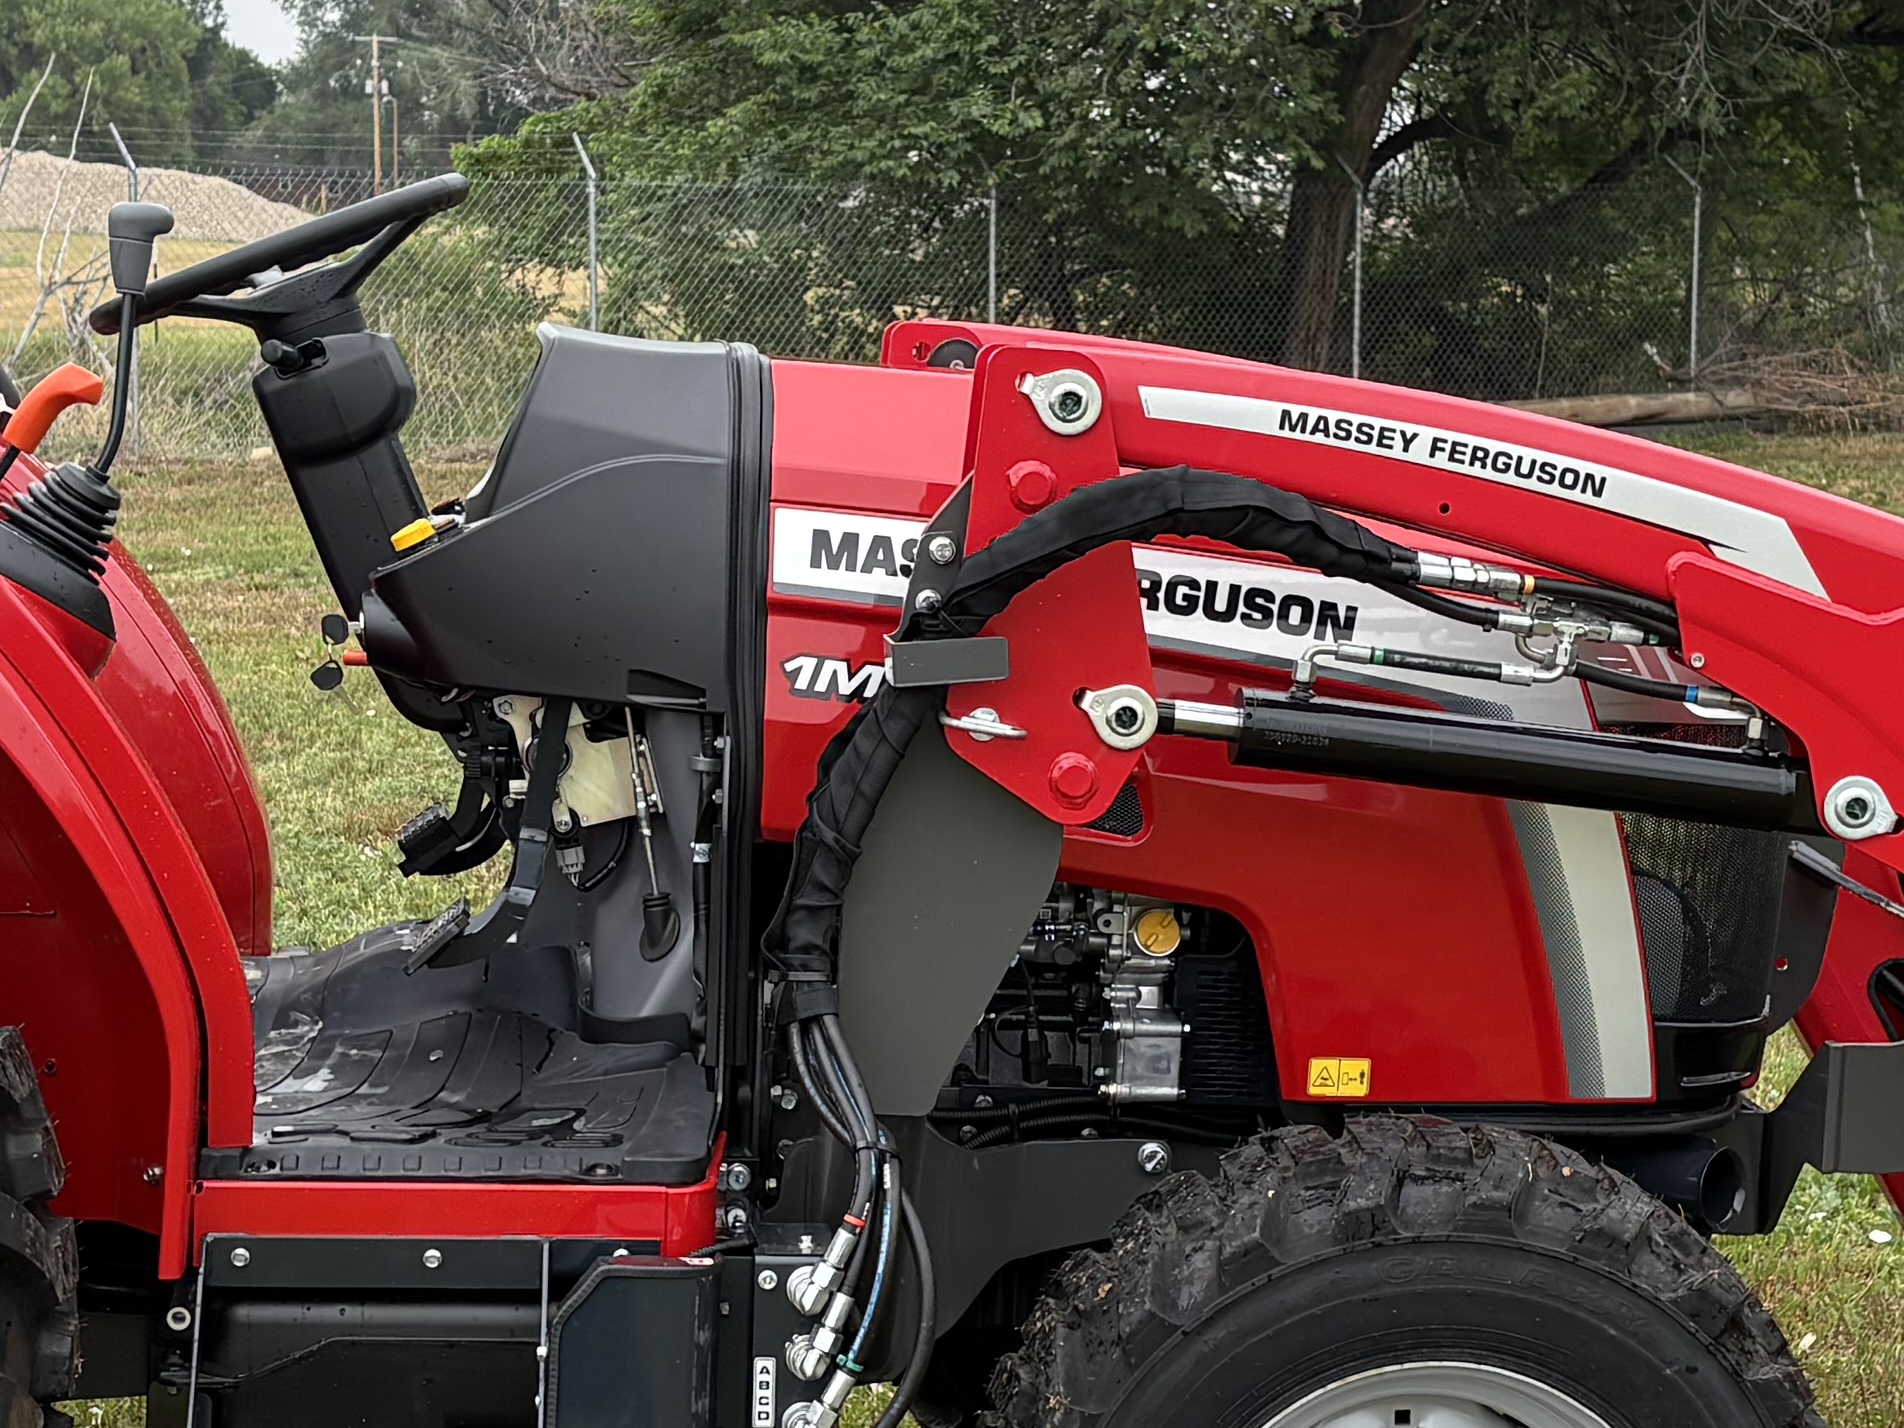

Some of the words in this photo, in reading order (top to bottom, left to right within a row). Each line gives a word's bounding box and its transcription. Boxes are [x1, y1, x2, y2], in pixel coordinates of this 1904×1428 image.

[1278, 408, 1420, 454] MASSEY
[1428, 436, 1608, 499] FERGUSON
[759, 1365, 771, 1375] A
[758, 1380, 770, 1390] B
[758, 1396, 770, 1406] C
[757, 1411, 770, 1421] D
